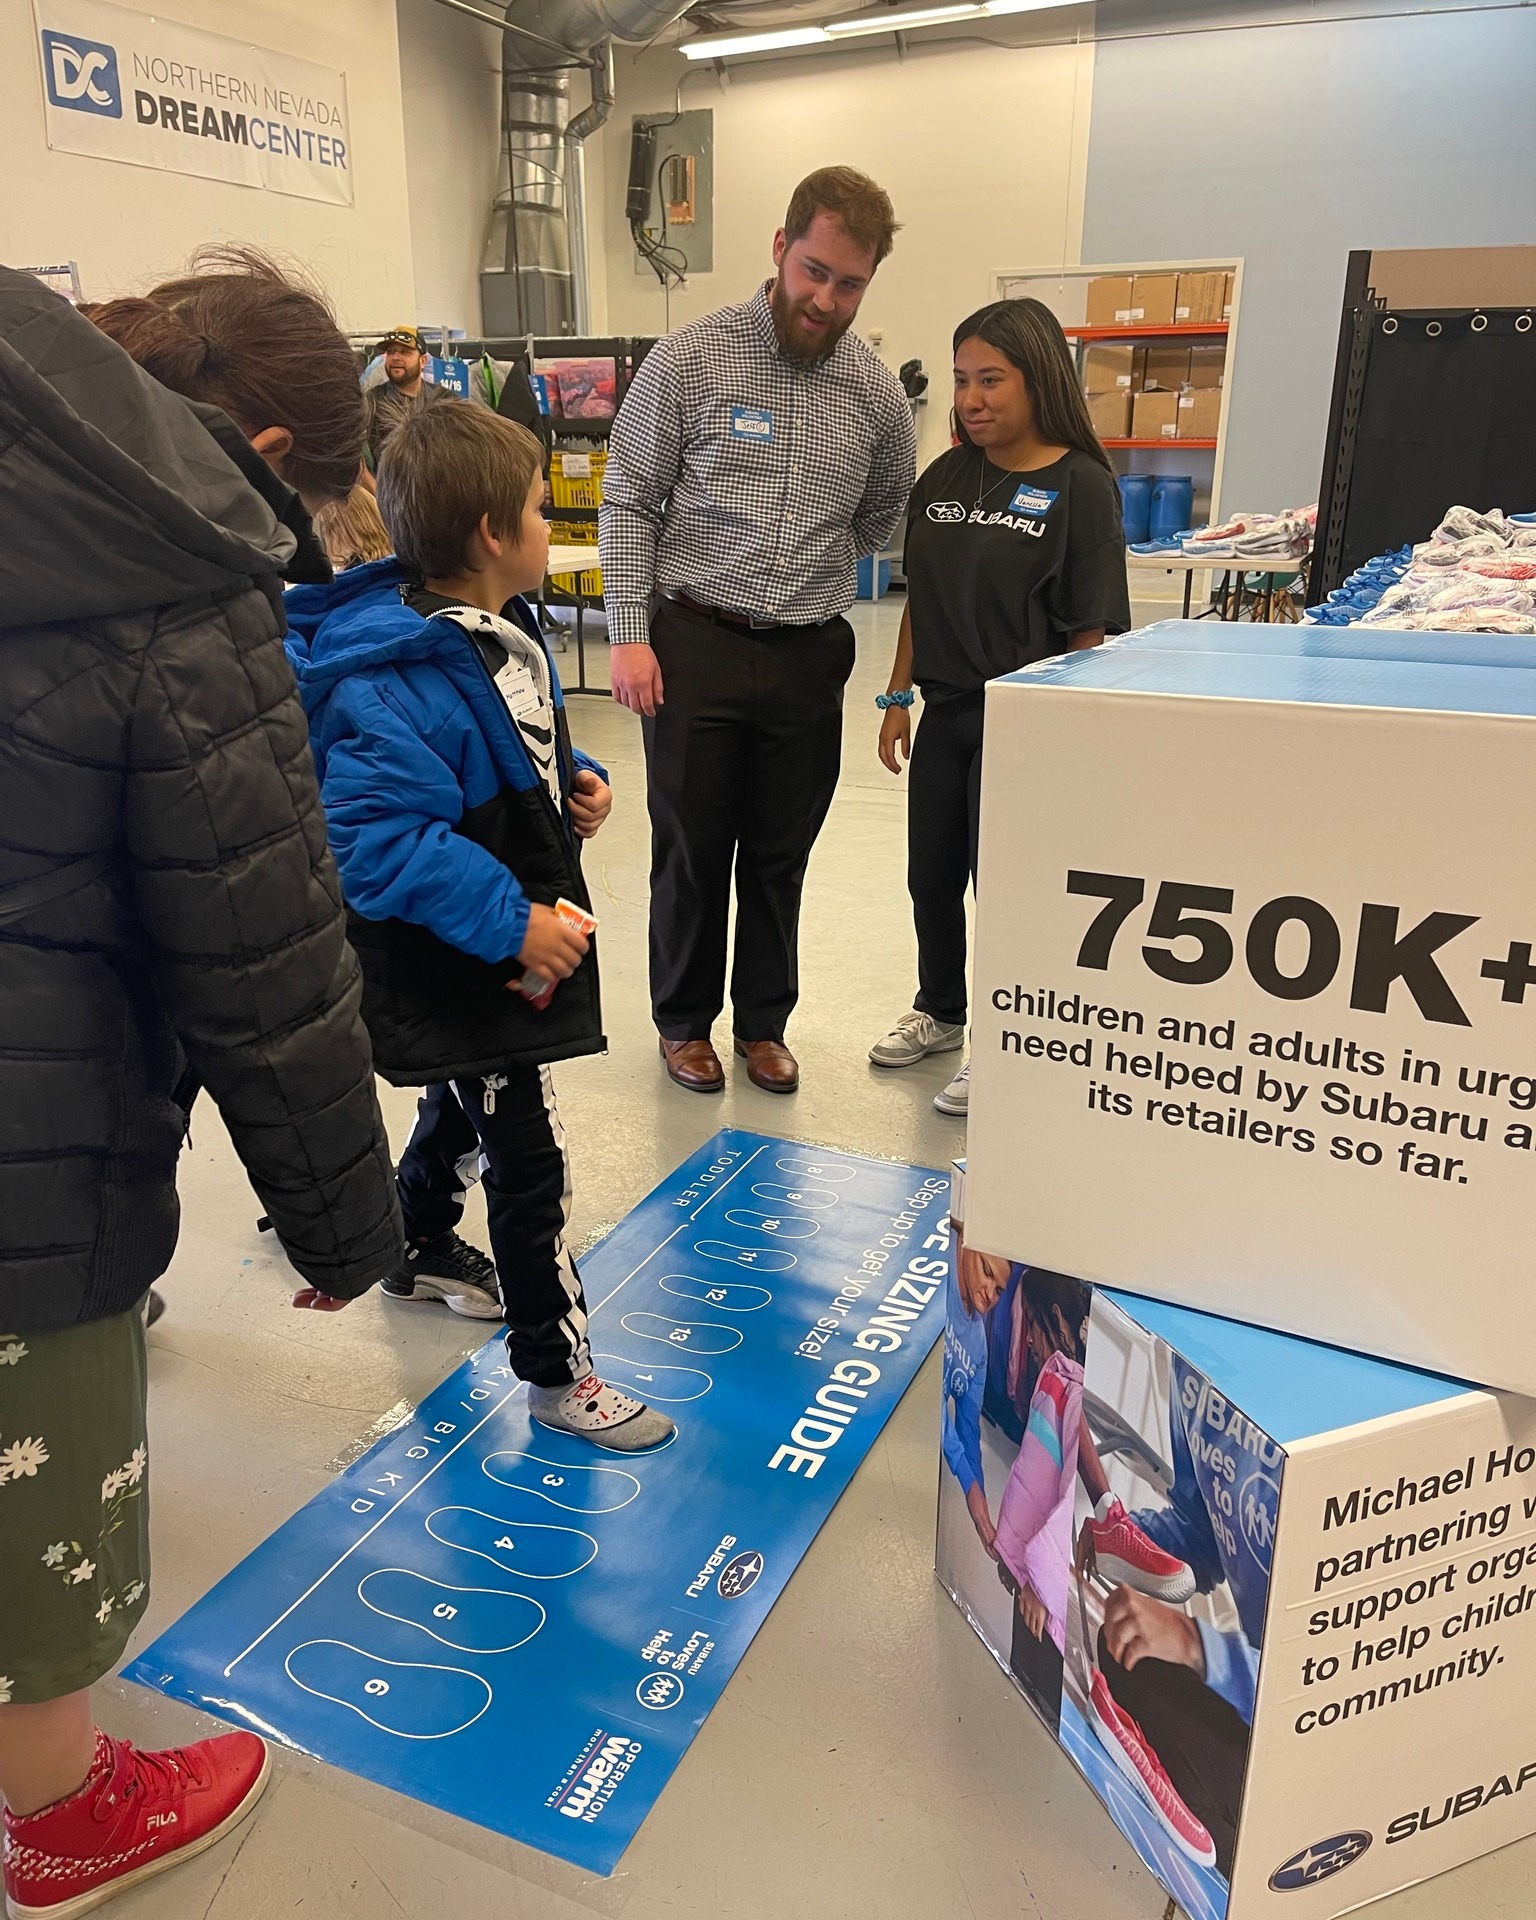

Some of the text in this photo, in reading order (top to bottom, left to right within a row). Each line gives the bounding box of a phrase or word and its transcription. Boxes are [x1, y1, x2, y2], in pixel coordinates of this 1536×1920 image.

[133, 52, 343, 129] NORTHERN NEVADA
[134, 89, 347, 170] DREAMCENTER
[967, 509, 1047, 538] SUBARU
[1066, 869, 1536, 1028] 750K+
[991, 984, 1144, 1035] children
[1157, 1017, 1235, 1051] and
[1248, 1031, 1386, 1077] adults
[1400, 1048, 1440, 1087] in
[1000, 1030, 1536, 1152] need helped by Subaru a
[1087, 1081, 1470, 1185] its retailers so far.
[672, 1149, 742, 1209] TODDLER
[806, 1166, 823, 1176] 8
[786, 1192, 803, 1200] 9
[761, 1219, 782, 1231] 10
[736, 1251, 758, 1263] 11
[793, 1177, 950, 1361] Step up to get your size!
[704, 1288, 728, 1303] 12
[852, 1256, 949, 1353] SIZING
[667, 1327, 693, 1343] 13
[634, 1373, 655, 1383] 1
[404, 1419, 456, 1461] BIG
[767, 1359, 881, 1479] GUIDE
[1184, 1416, 1236, 1484] oves
[350, 1470, 404, 1515] KID
[542, 1473, 564, 1488] 3
[1212, 1475, 1233, 1517] to
[1322, 1457, 1474, 1531] Michael
[493, 1535, 515, 1551] 4
[1205, 1498, 1237, 1557] elp
[1313, 1499, 1510, 1591] partnering
[684, 1534, 737, 1599] SUBARU
[432, 1602, 458, 1621] 5
[1307, 1563, 1458, 1636] support
[640, 1628, 673, 1663] Help
[656, 1653, 677, 1666] to
[671, 1630, 710, 1672] Loves
[687, 1641, 715, 1676] SUBARU
[1301, 1652, 1338, 1686] to
[1350, 1624, 1430, 1673] help
[364, 1678, 390, 1697] 6
[1293, 1642, 1505, 1735] community.
[582, 1728, 603, 1753] more
[559, 1735, 631, 1819] warm
[566, 1754, 586, 1776] than
[581, 1741, 642, 1823] OPERATION
[544, 1785, 563, 1807] coat
[146, 1810, 179, 1832] FILA
